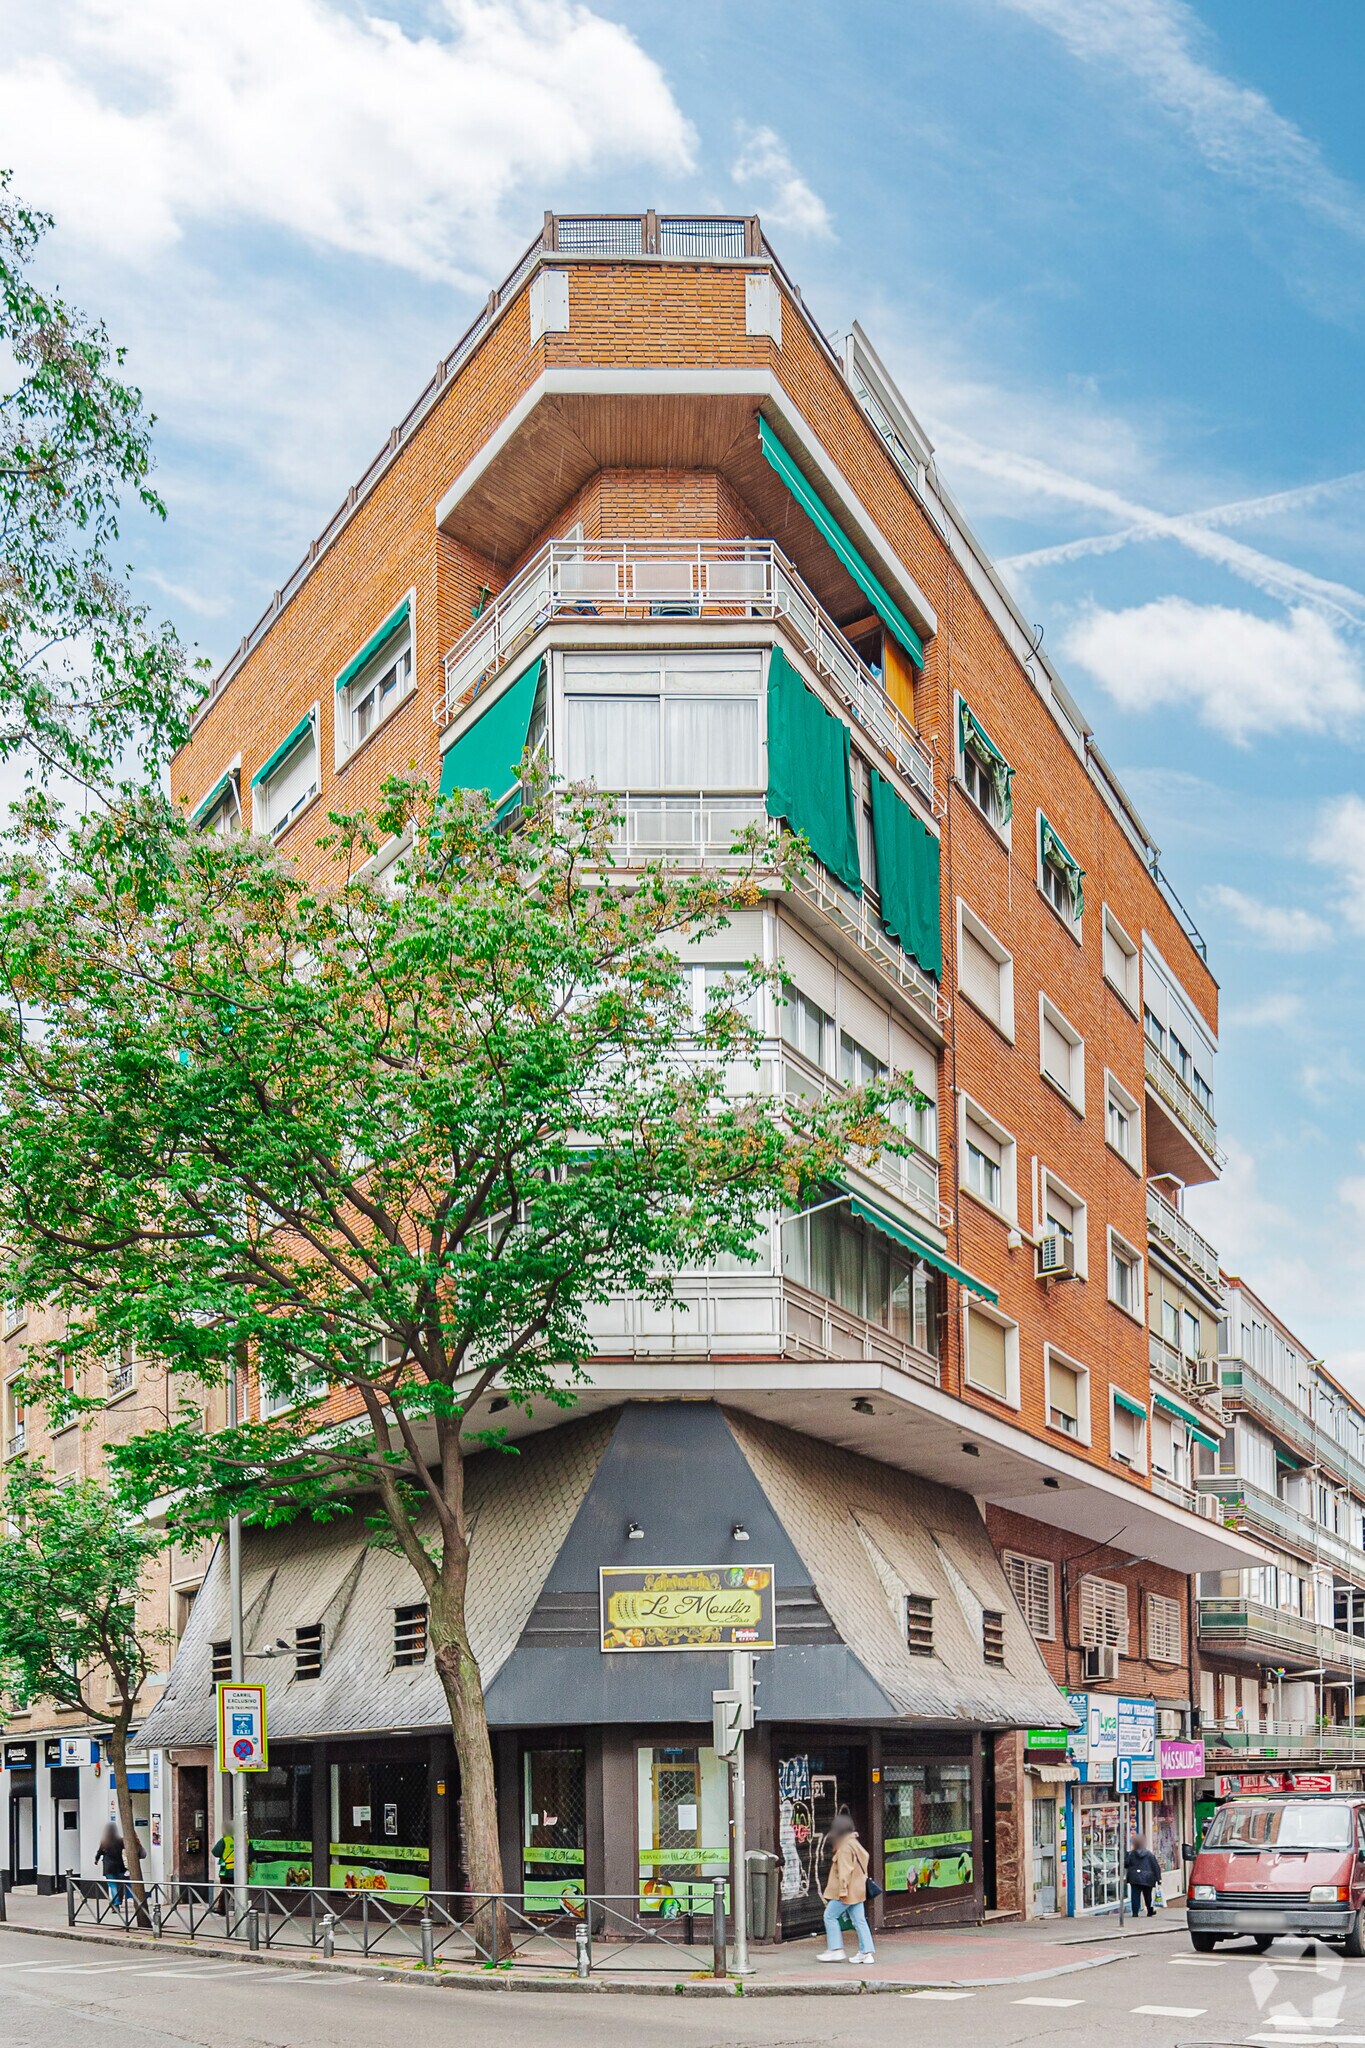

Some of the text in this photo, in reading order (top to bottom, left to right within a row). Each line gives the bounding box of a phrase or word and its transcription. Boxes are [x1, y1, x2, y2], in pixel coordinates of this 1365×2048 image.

[641, 1594, 752, 1623] Le Moulin
[1066, 1695, 1086, 1704] FAX
[1100, 1711, 1117, 1732] Lyca
[1100, 1731, 1117, 1742] mobile
[1121, 1761, 1130, 1789] P
[1243, 1775, 1258, 1787] MINI
